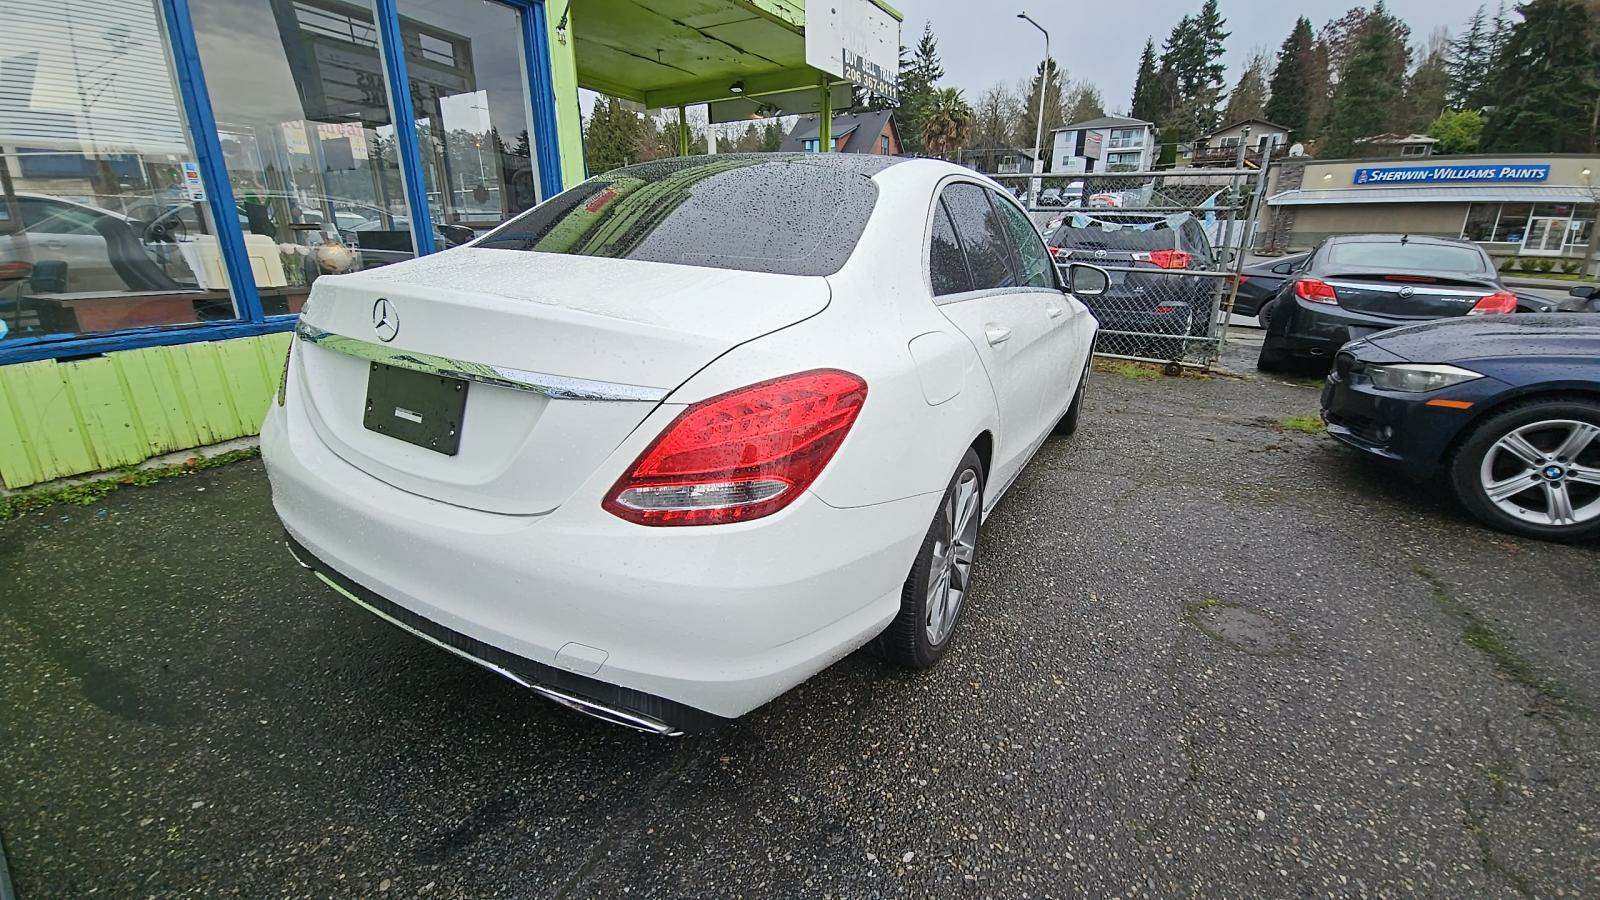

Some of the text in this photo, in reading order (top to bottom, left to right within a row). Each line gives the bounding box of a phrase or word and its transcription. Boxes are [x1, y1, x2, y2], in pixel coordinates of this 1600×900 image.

[845, 49, 858, 67] BUY
[862, 58, 876, 76] SELL
[846, 66, 861, 83] 206
[1369, 167, 1545, 182] SHERWIN-WILLIAMS PAINTS
